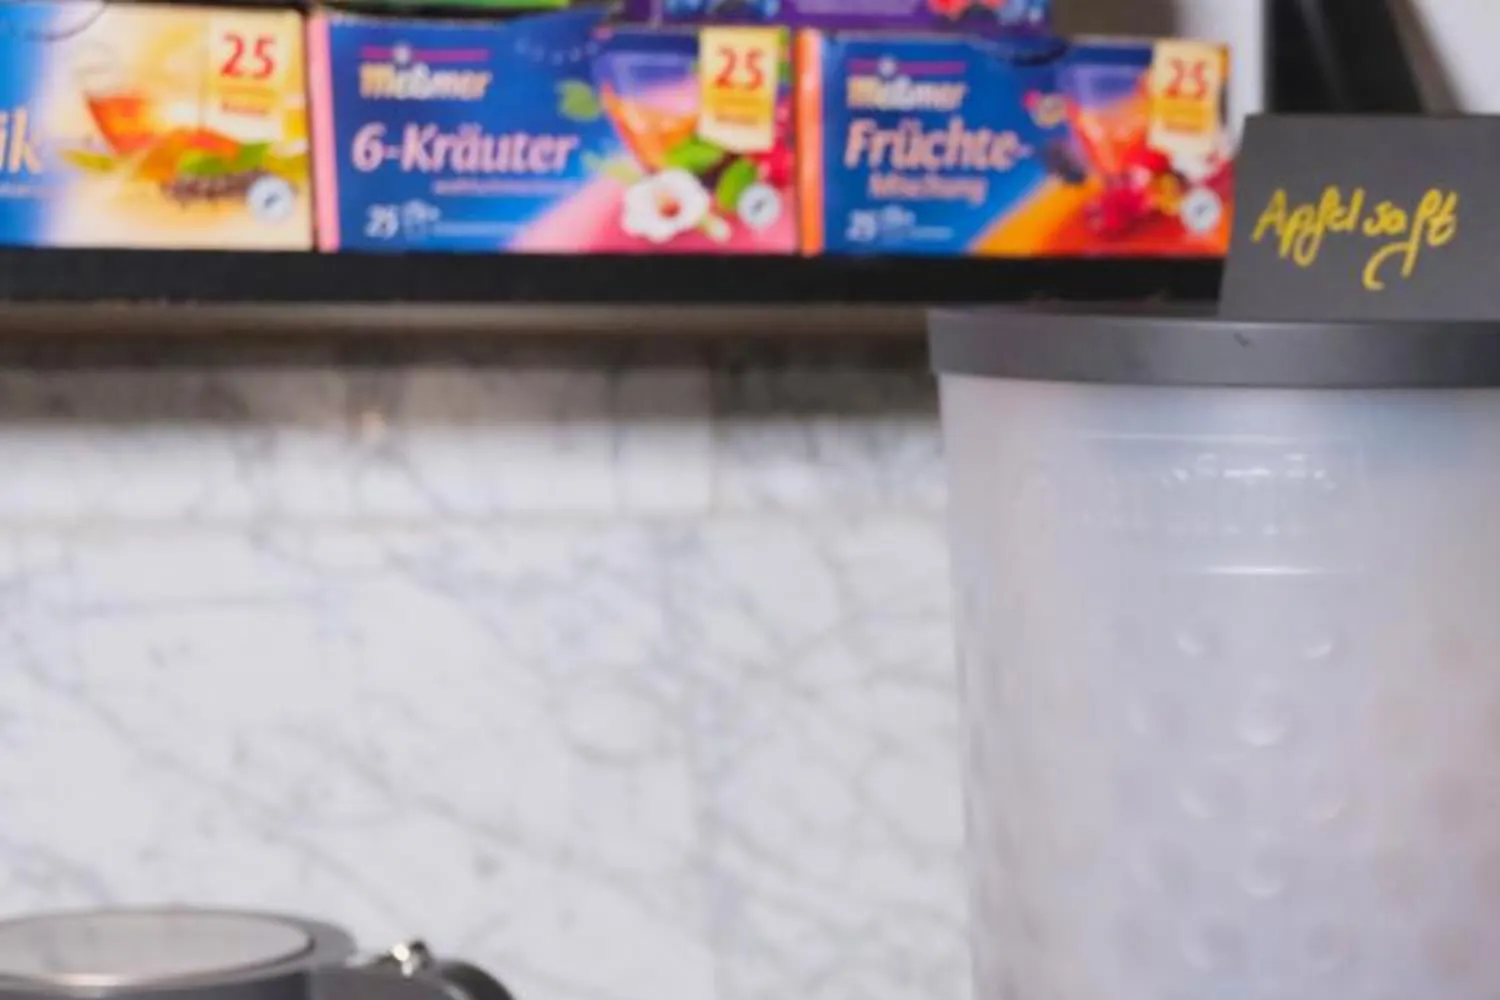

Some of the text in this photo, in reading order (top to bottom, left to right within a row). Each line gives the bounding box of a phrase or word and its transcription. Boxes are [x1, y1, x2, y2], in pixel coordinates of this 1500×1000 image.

[219, 32, 277, 80] 25
[715, 46, 765, 90] 25
[1163, 57, 1208, 101] 25
[352, 122, 579, 173] 6-Kräuter
[843, 116, 1034, 172] Früchte-
[1251, 183, 1459, 292] Apfelsaft
